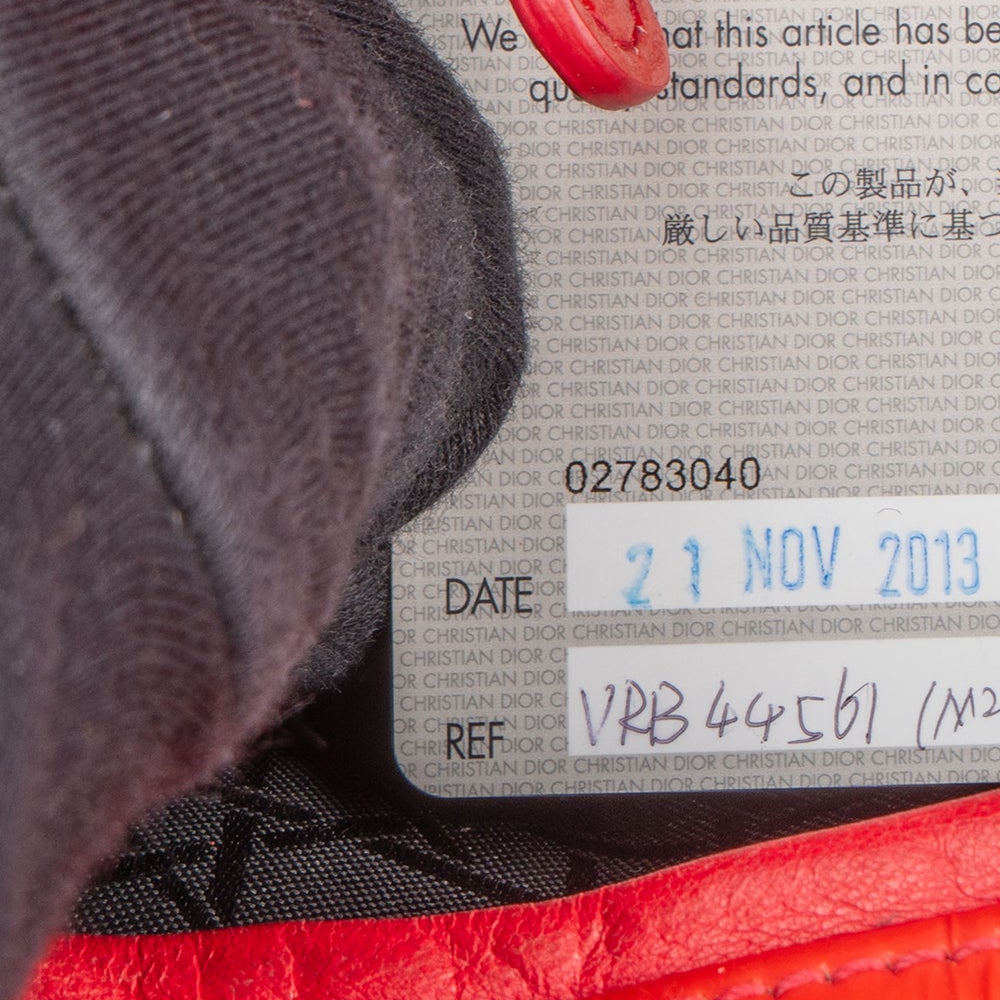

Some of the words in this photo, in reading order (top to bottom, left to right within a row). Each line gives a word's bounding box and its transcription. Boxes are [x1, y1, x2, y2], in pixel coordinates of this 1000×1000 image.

[460, 16, 518, 53] We
[661, 19, 703, 49] at
[716, 11, 768, 48] this
[782, 9, 880, 47] article
[896, 7, 950, 45] has
[844, 58, 906, 97] and
[924, 63, 949, 95] in
[564, 456, 761, 495] 02783040
[743, 524, 841, 593] NOV
[878, 528, 980, 598] 2013
[445, 576, 533, 615] DATE
[446, 721, 504, 760] REF
